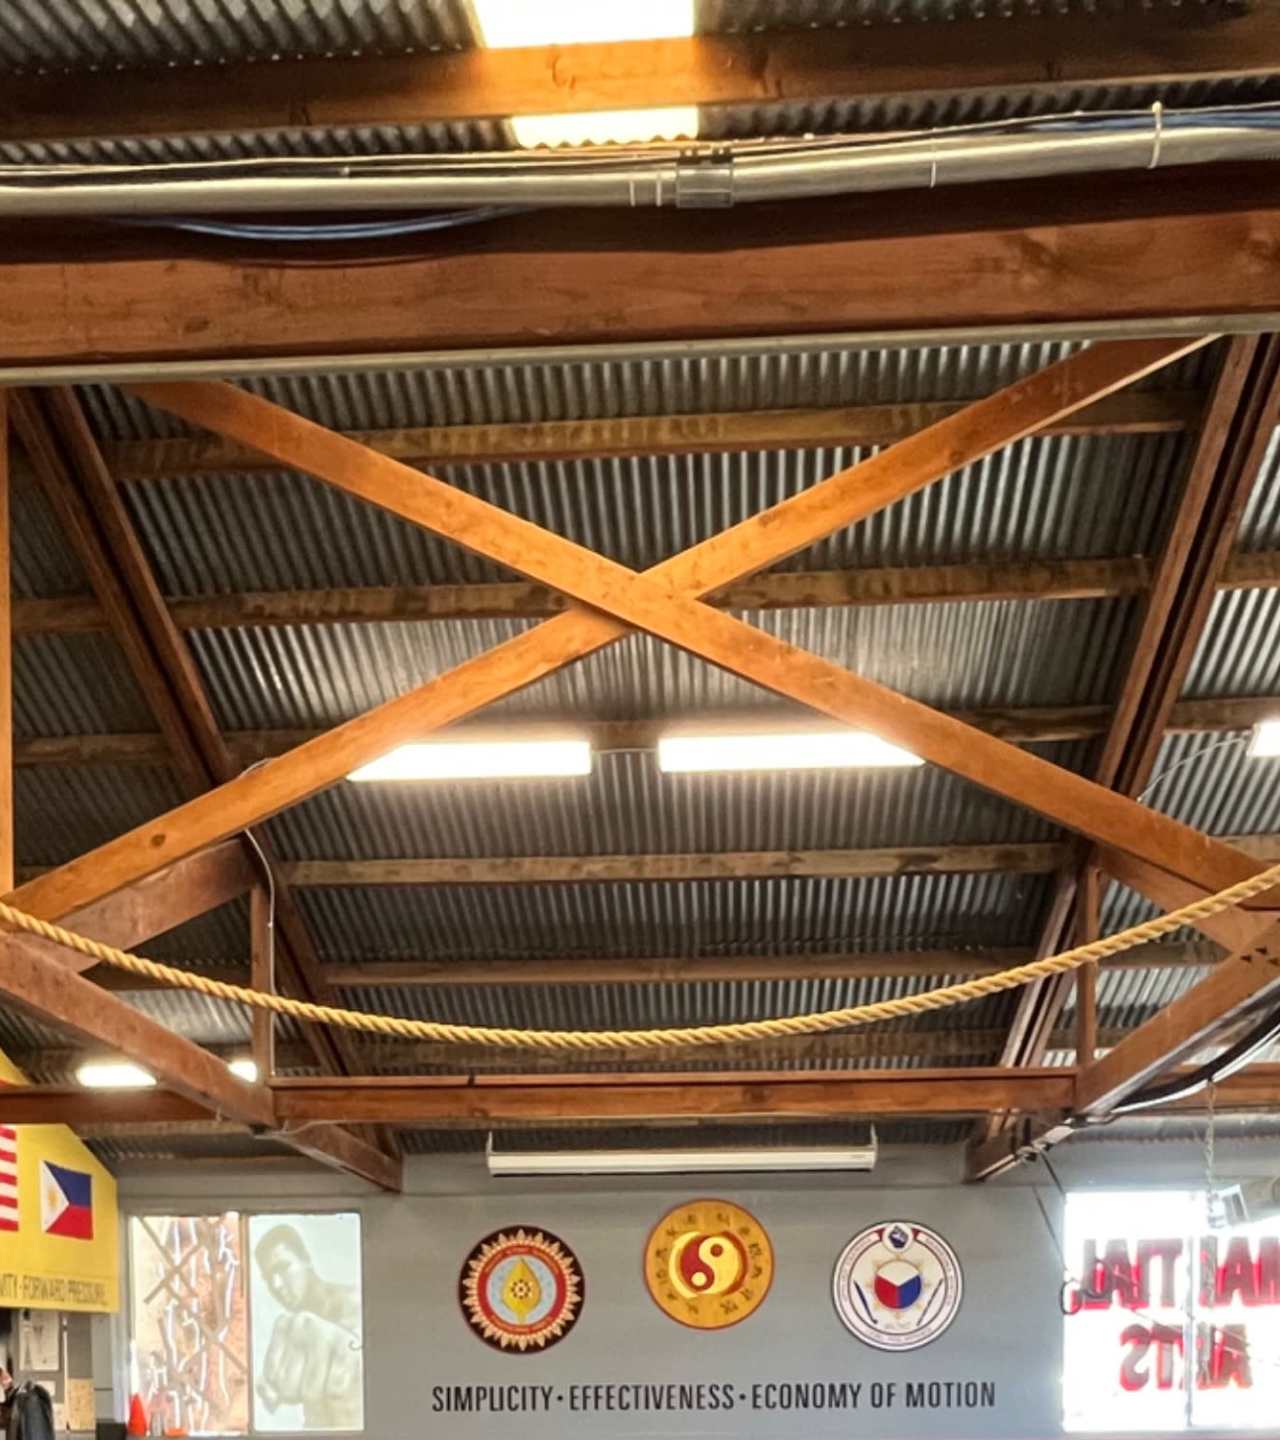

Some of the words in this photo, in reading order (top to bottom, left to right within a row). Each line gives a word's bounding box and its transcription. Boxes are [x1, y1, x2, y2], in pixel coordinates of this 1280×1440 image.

[432, 1385, 554, 1412] SIMPLICITY
[569, 1383, 735, 1411] EFFECTIVENESS
[752, 1382, 861, 1410] ECONOMY
[870, 1382, 897, 1408] OF
[905, 1381, 996, 1408] MOTION
